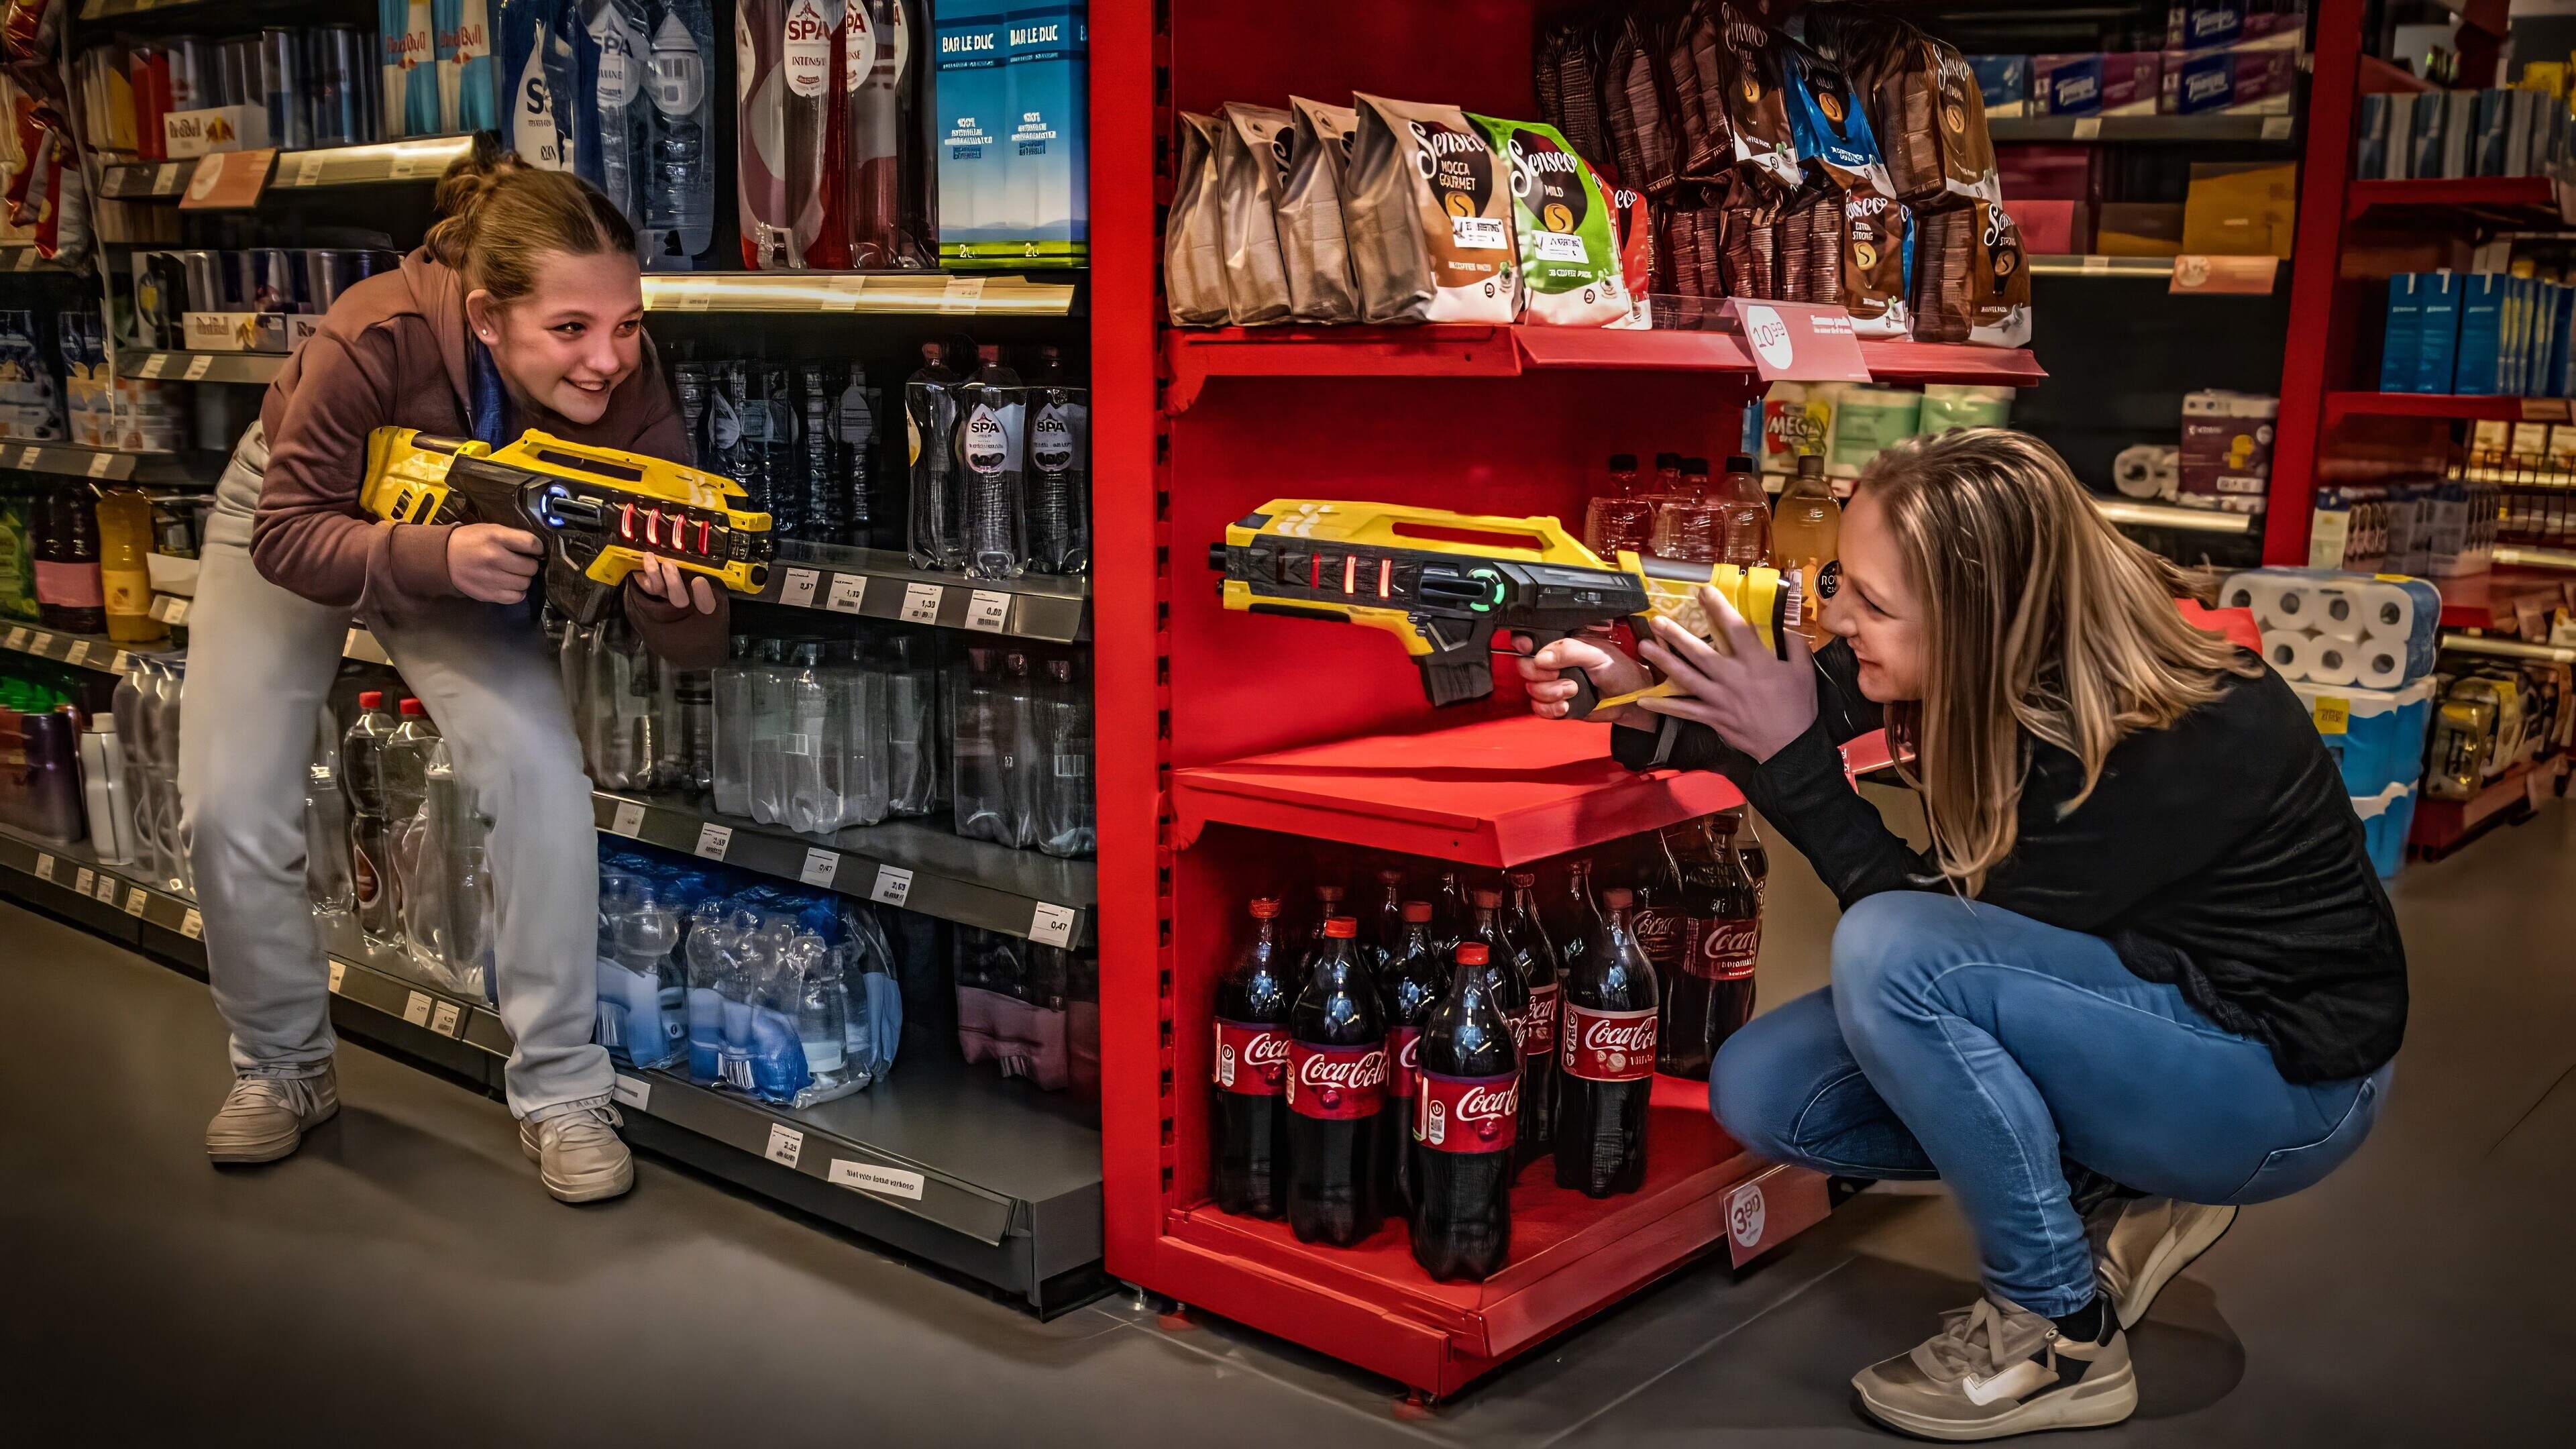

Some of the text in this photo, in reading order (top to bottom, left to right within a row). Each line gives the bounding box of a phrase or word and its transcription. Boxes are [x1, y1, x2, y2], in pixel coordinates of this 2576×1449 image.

[788, 20, 831, 40] SPA
[847, 13, 867, 34] PA
[974, 33, 994, 50] DUC
[1039, 24, 1058, 42] DUC
[1441, 160, 1470, 175] MOCCA
[1507, 139, 1577, 198] Senseo
[1440, 173, 1476, 191] GOURMET
[1544, 185, 1564, 197] MILD
[971, 423, 1000, 433] SPA
[1037, 422, 1065, 433] SPA
